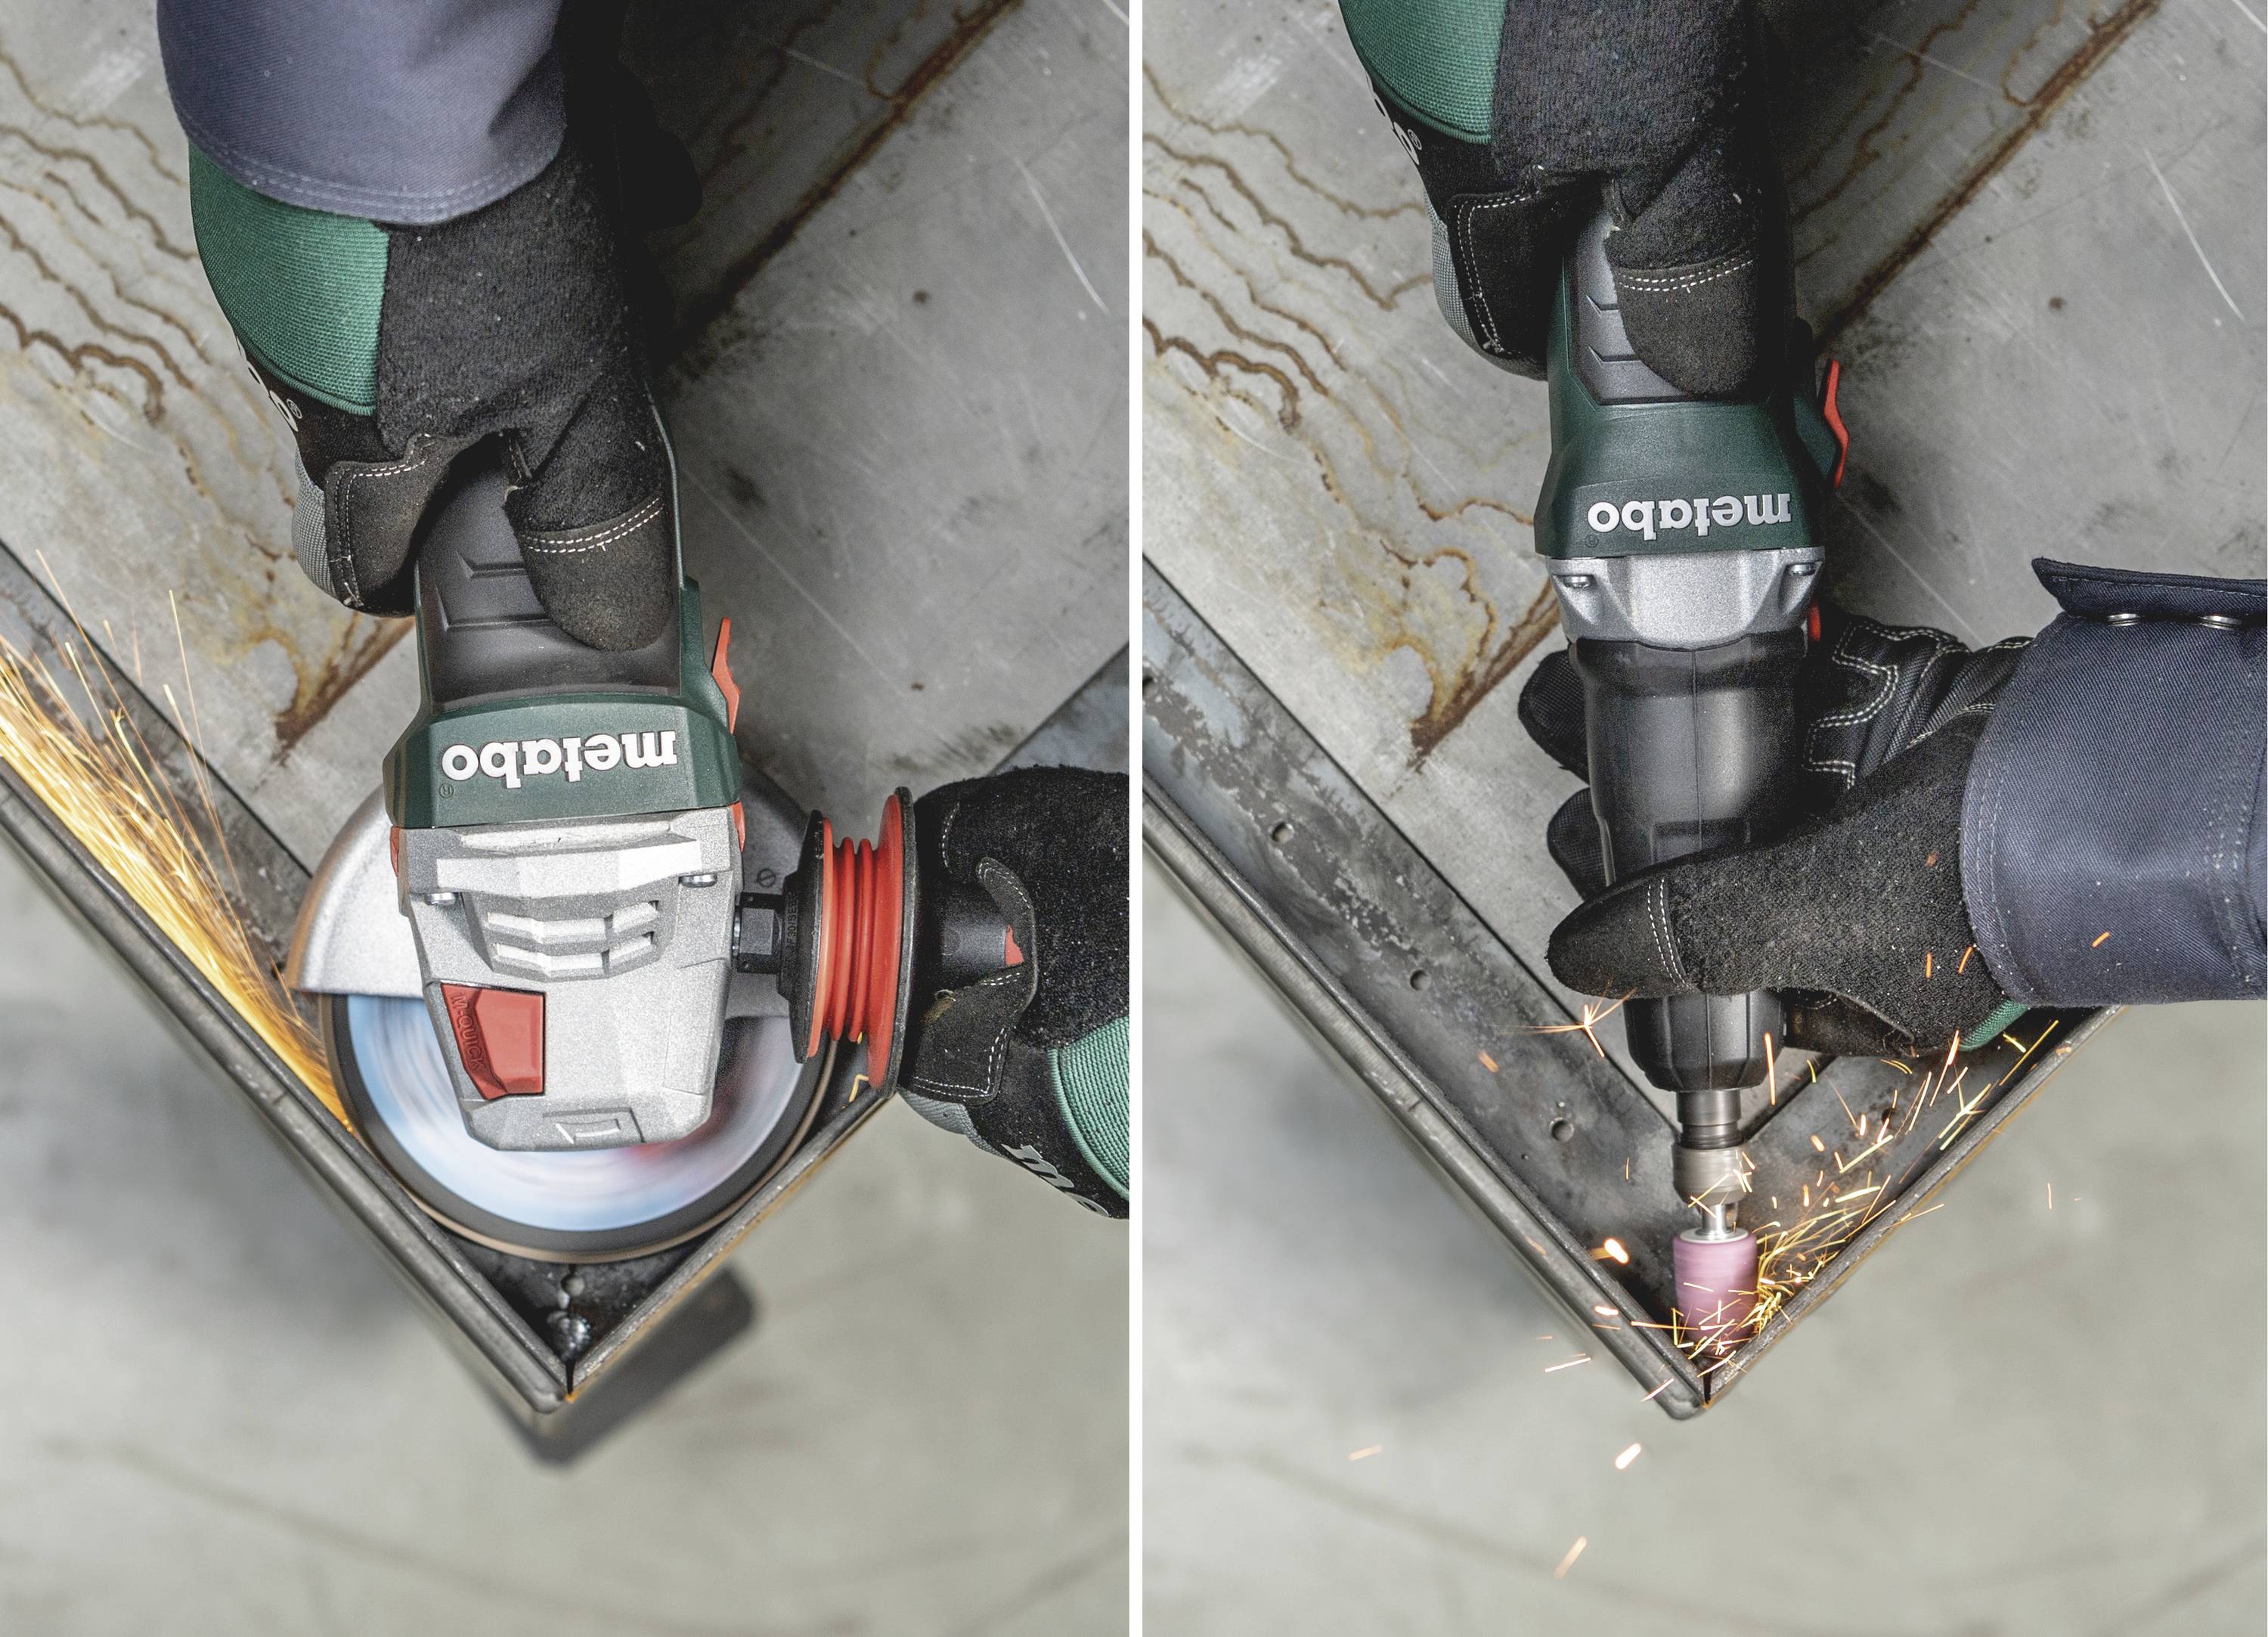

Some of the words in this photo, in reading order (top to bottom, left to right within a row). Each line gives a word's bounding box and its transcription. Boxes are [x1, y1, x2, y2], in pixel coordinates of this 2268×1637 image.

[1588, 493, 1792, 541] metabo
[442, 730, 677, 789] metabo
[451, 995, 485, 1071] M-QUICK
